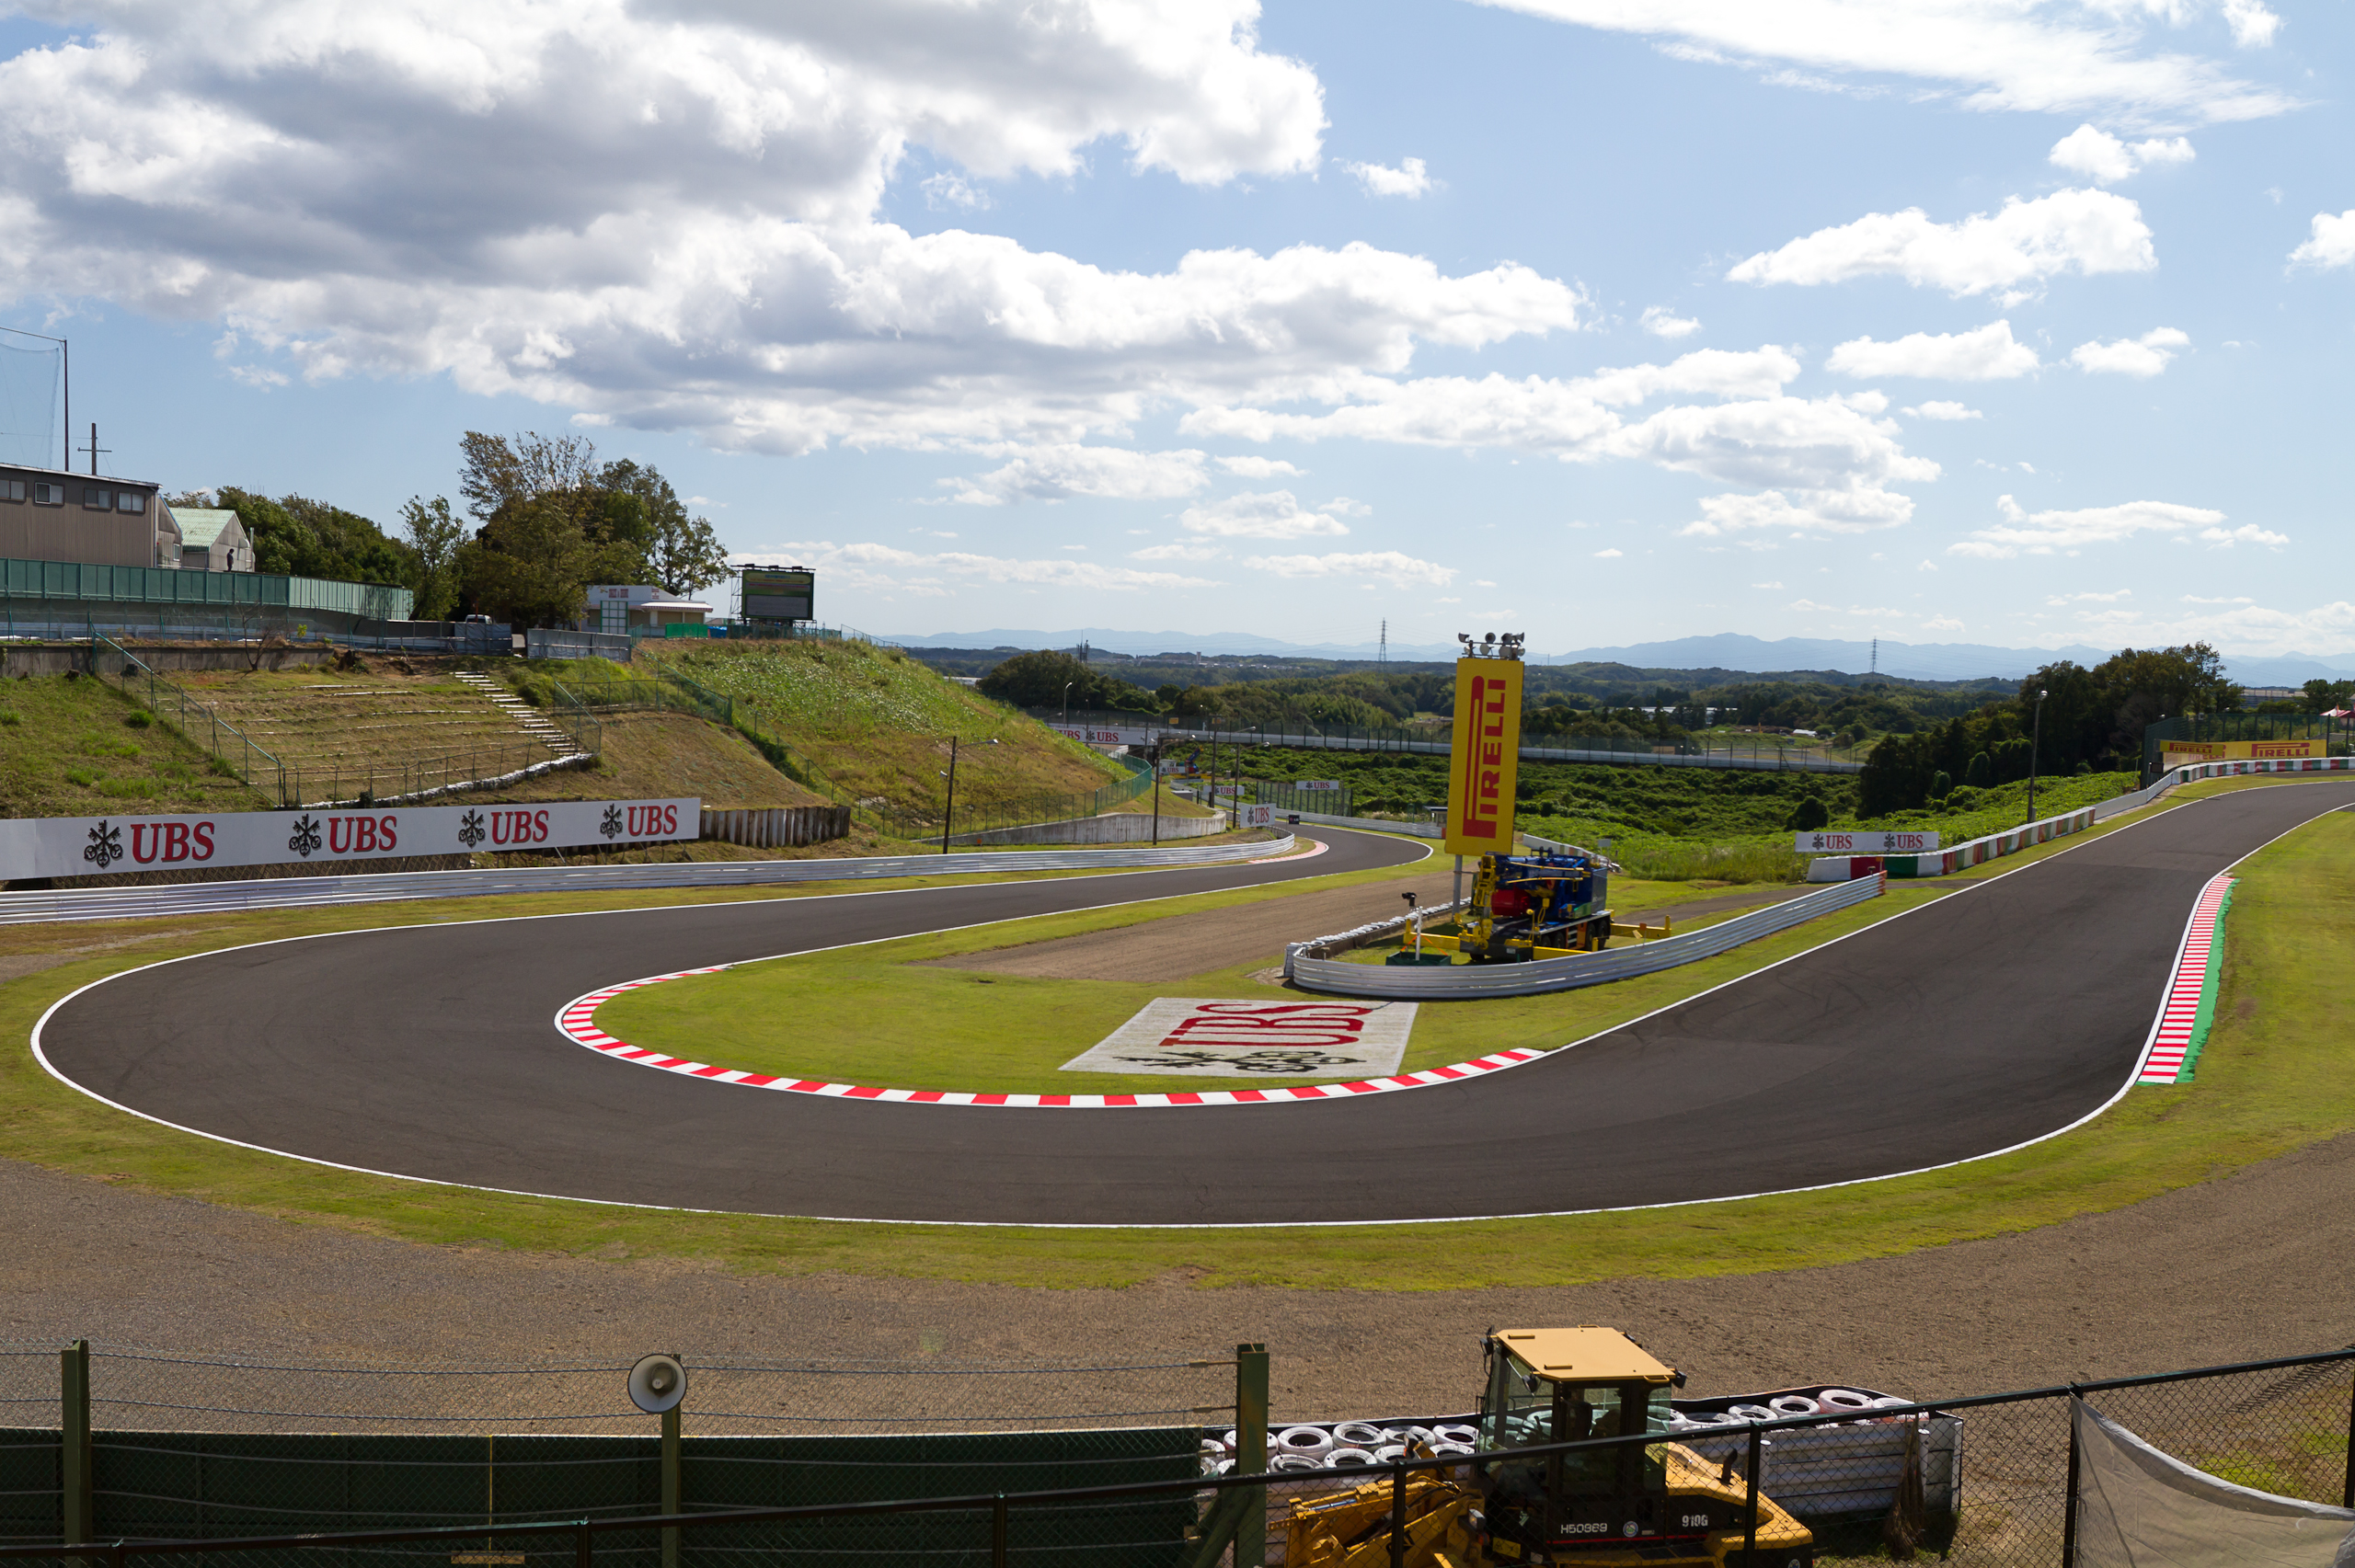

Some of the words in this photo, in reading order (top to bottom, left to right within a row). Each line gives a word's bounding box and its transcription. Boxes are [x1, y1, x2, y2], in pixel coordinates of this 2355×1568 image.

[1097, 731, 1119, 742] UBS
[2168, 742, 2212, 754] PIRELLI
[2251, 742, 2310, 758] PIRELLI
[1463, 675, 1506, 839] PIRELLI
[1220, 786, 1236, 795] UBS
[627, 805, 677, 836] UBS
[1255, 807, 1269, 823] UBS
[327, 816, 396, 853] UBS
[490, 809, 549, 844] UBS
[130, 821, 214, 864] UBS
[1826, 834, 1853, 849] UBS
[1897, 834, 1924, 848] UBS
[1158, 1002, 1373, 1047] UBS
[1682, 1515, 1708, 1527] 910G
